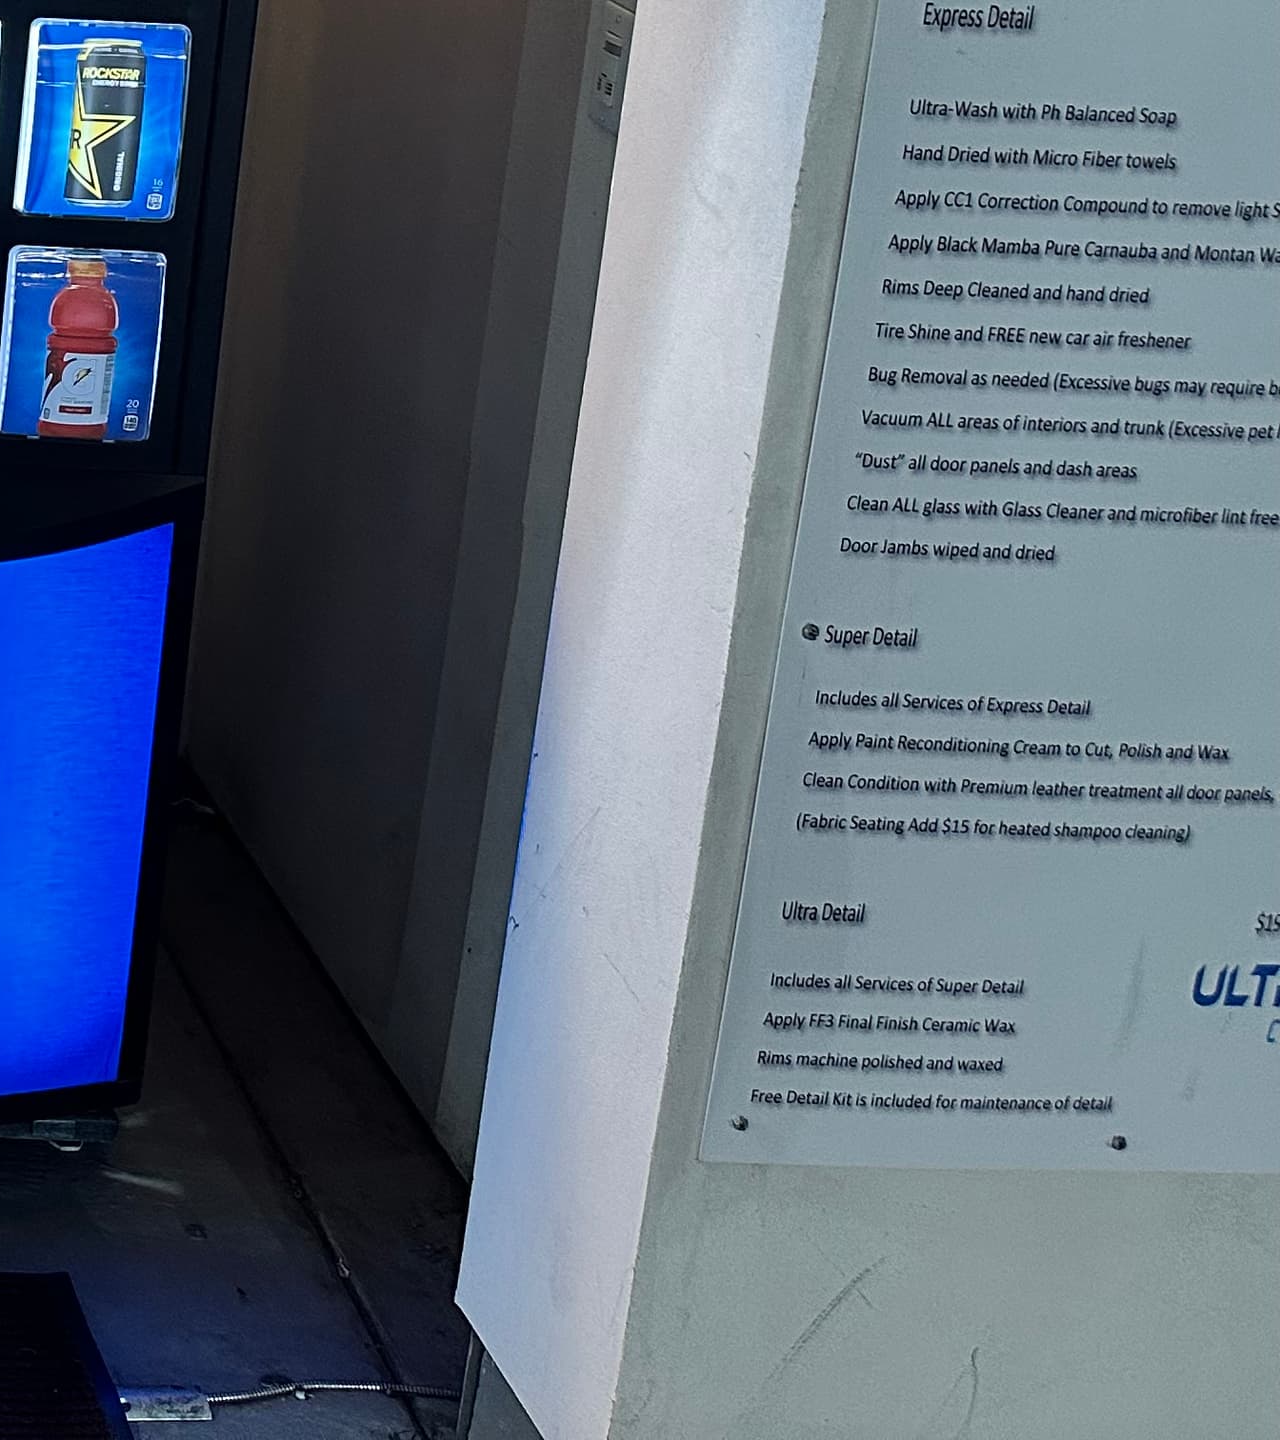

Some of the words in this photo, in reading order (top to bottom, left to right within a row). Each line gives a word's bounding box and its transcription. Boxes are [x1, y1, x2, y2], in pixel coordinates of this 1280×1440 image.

[922, 2, 985, 33] Express
[986, 4, 1036, 33] Detail
[82, 66, 141, 81] ROCKSTAR
[909, 98, 998, 119] Ultra-Wash
[1002, 102, 1037, 122] with
[1040, 103, 1061, 121] Ph
[1064, 104, 1137, 126] Balanced
[1138, 107, 1178, 130] Soap
[70, 128, 82, 150] R
[902, 144, 945, 162] Hand
[947, 145, 991, 164] Dried
[994, 148, 1029, 167] with
[1032, 149, 1079, 167] Micro
[1081, 150, 1123, 169] Fiber
[1125, 152, 1177, 172] towels
[152, 177, 164, 188] 16
[881, 278, 920, 296] Rims
[922, 280, 964, 301] Deep
[967, 281, 1030, 300] Cleaned
[1032, 284, 1063, 301] and
[1065, 284, 1106, 304] hand
[1108, 286, 1151, 306] dried
[875, 322, 905, 340] Tire
[907, 323, 951, 342] Shine
[953, 325, 984, 343] and
[987, 326, 1026, 344] FREE
[1028, 331, 1062, 347] new
[1065, 332, 1091, 347] car
[1092, 331, 1115, 348] air
[1117, 330, 1193, 351] freshener
[125, 398, 140, 409] 20
[907, 454, 927, 473] all
[929, 455, 967, 473] door
[969, 458, 1021, 476] panels
[1022, 459, 1053, 479] and
[1055, 460, 1093, 478] dash
[1095, 465, 1138, 481] areas
[839, 537, 879, 555] Door
[879, 539, 929, 559] Jambs
[932, 542, 980, 561] wiped
[981, 543, 1012, 562] and
[1014, 544, 1057, 564] dried
[823, 624, 871, 650] Super
[872, 627, 919, 651] Detail
[807, 731, 852, 753] Apply
[855, 733, 895, 752] Paint
[897, 735, 1010, 759] Reconditioning
[1013, 739, 1062, 757] Cream
[1065, 743, 1081, 757] to
[1084, 741, 1114, 761] Cut,
[1118, 742, 1163, 761] Polish
[1165, 744, 1195, 762] and
[1197, 744, 1231, 764] Wax
[781, 900, 819, 925] Ultra
[821, 902, 866, 927] Detail
[1192, 963, 1280, 1007] ULT
[762, 1011, 806, 1031] Apply
[808, 1013, 835, 1028] FF3
[837, 1014, 873, 1031] Final
[875, 1015, 919, 1032] Finish
[922, 1017, 981, 1034] Ceramic
[984, 1018, 1016, 1037] Wax
